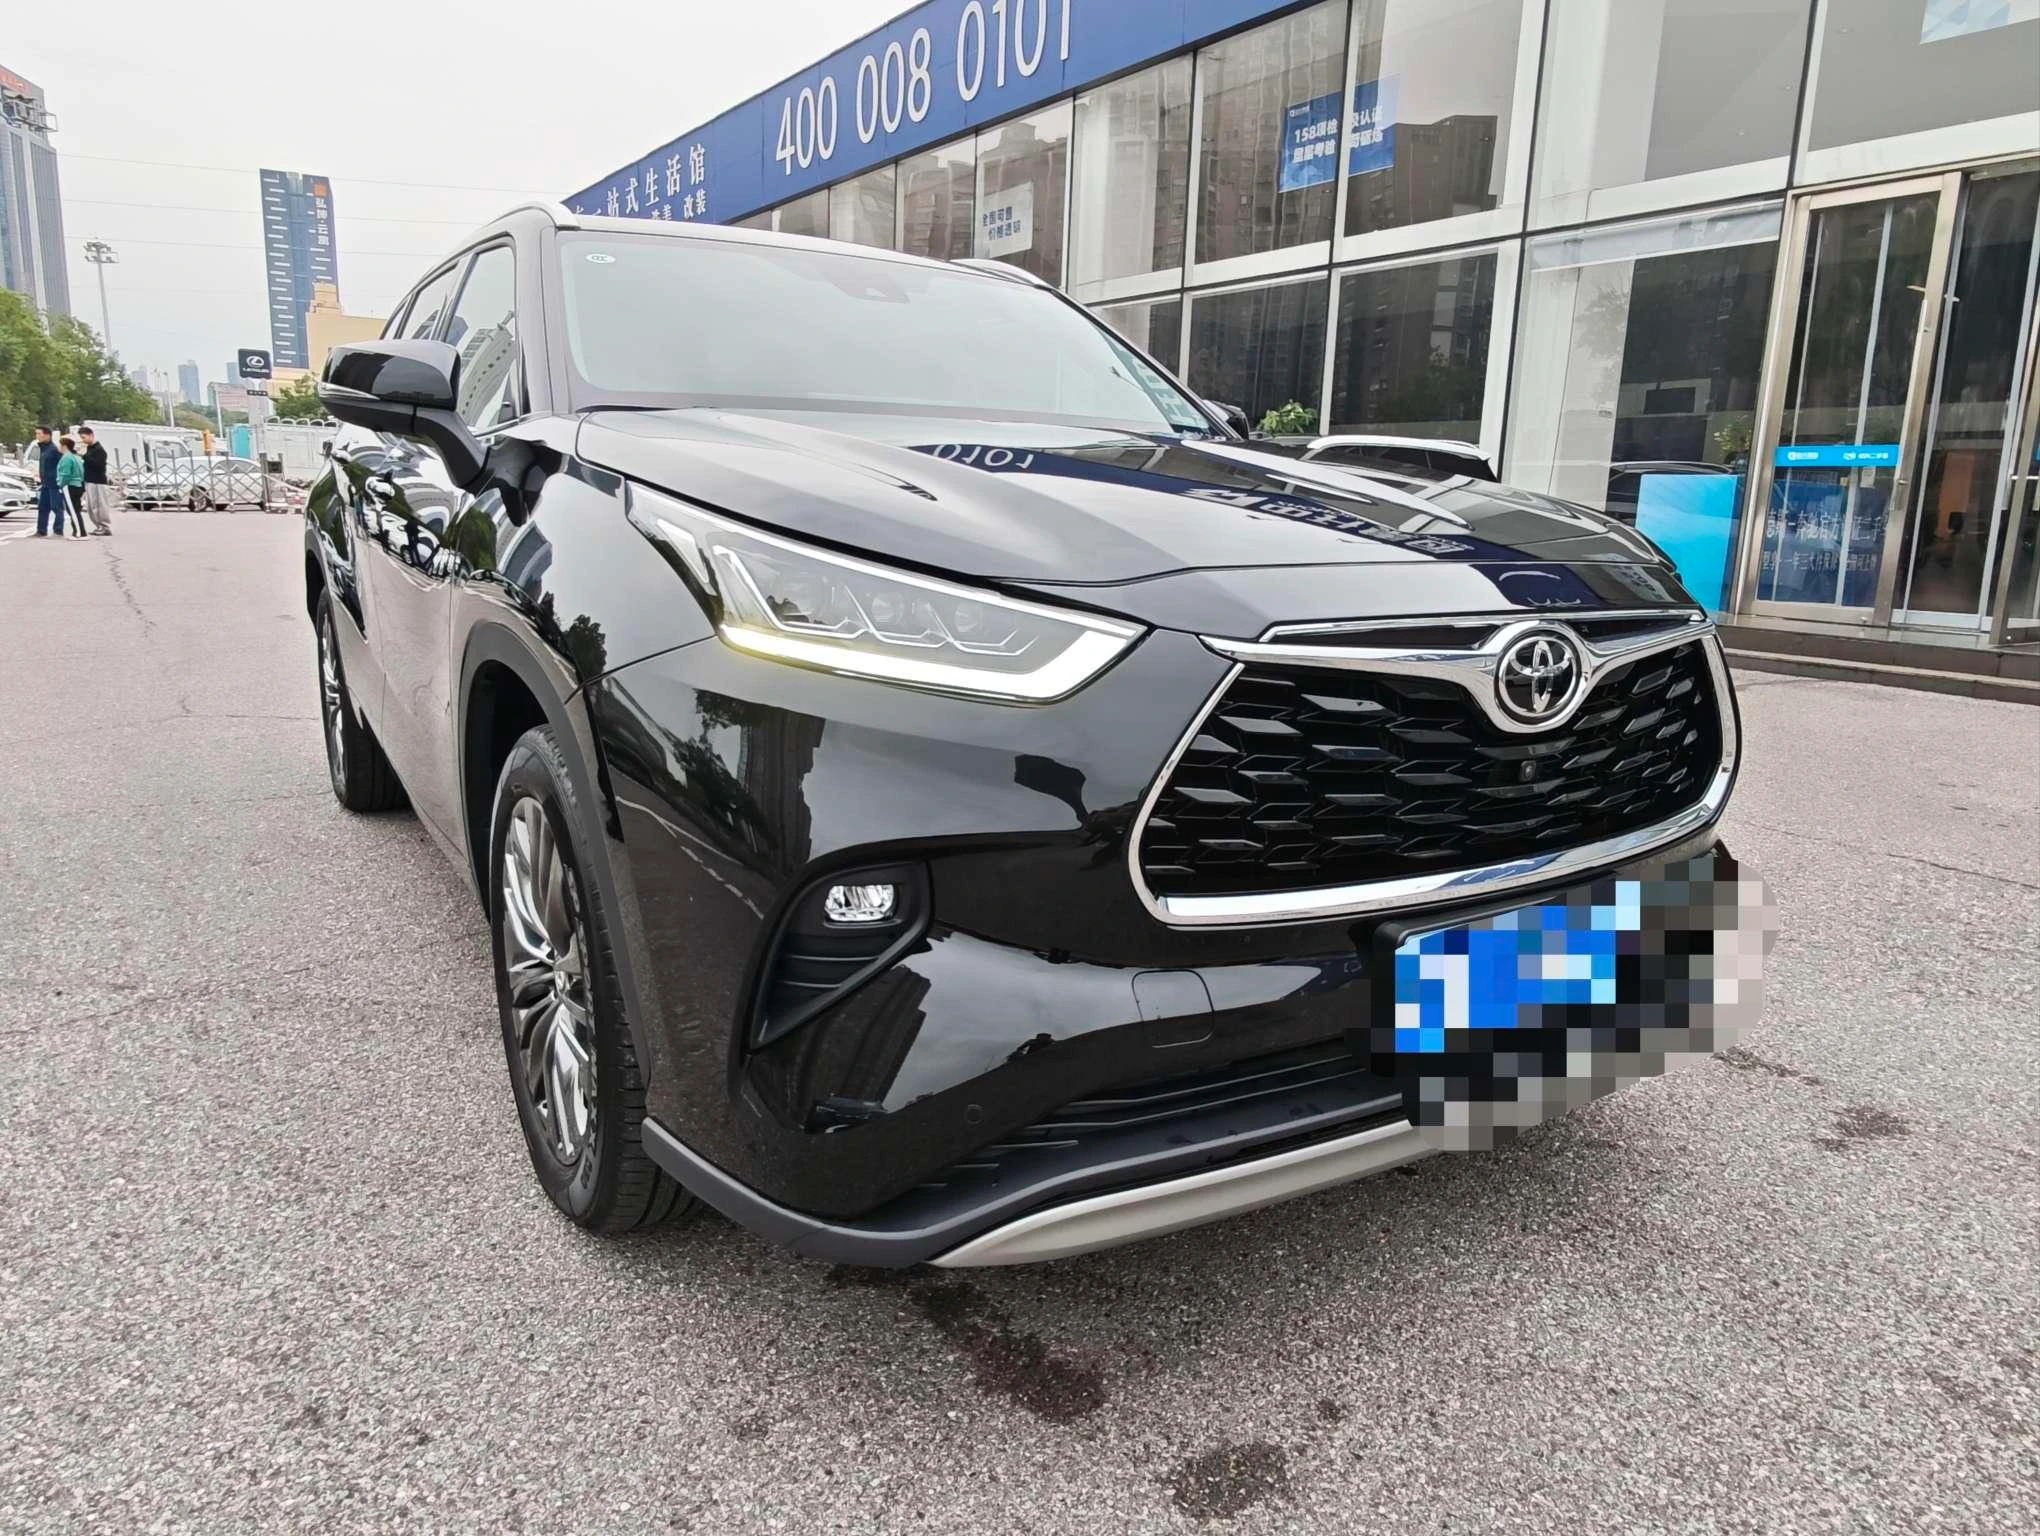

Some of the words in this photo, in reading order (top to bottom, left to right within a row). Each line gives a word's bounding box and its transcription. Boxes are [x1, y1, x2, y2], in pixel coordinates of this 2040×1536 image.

[775, 76, 838, 176] 400
[856, 27, 932, 144] 008
[956, 0, 1071, 102] 0101
